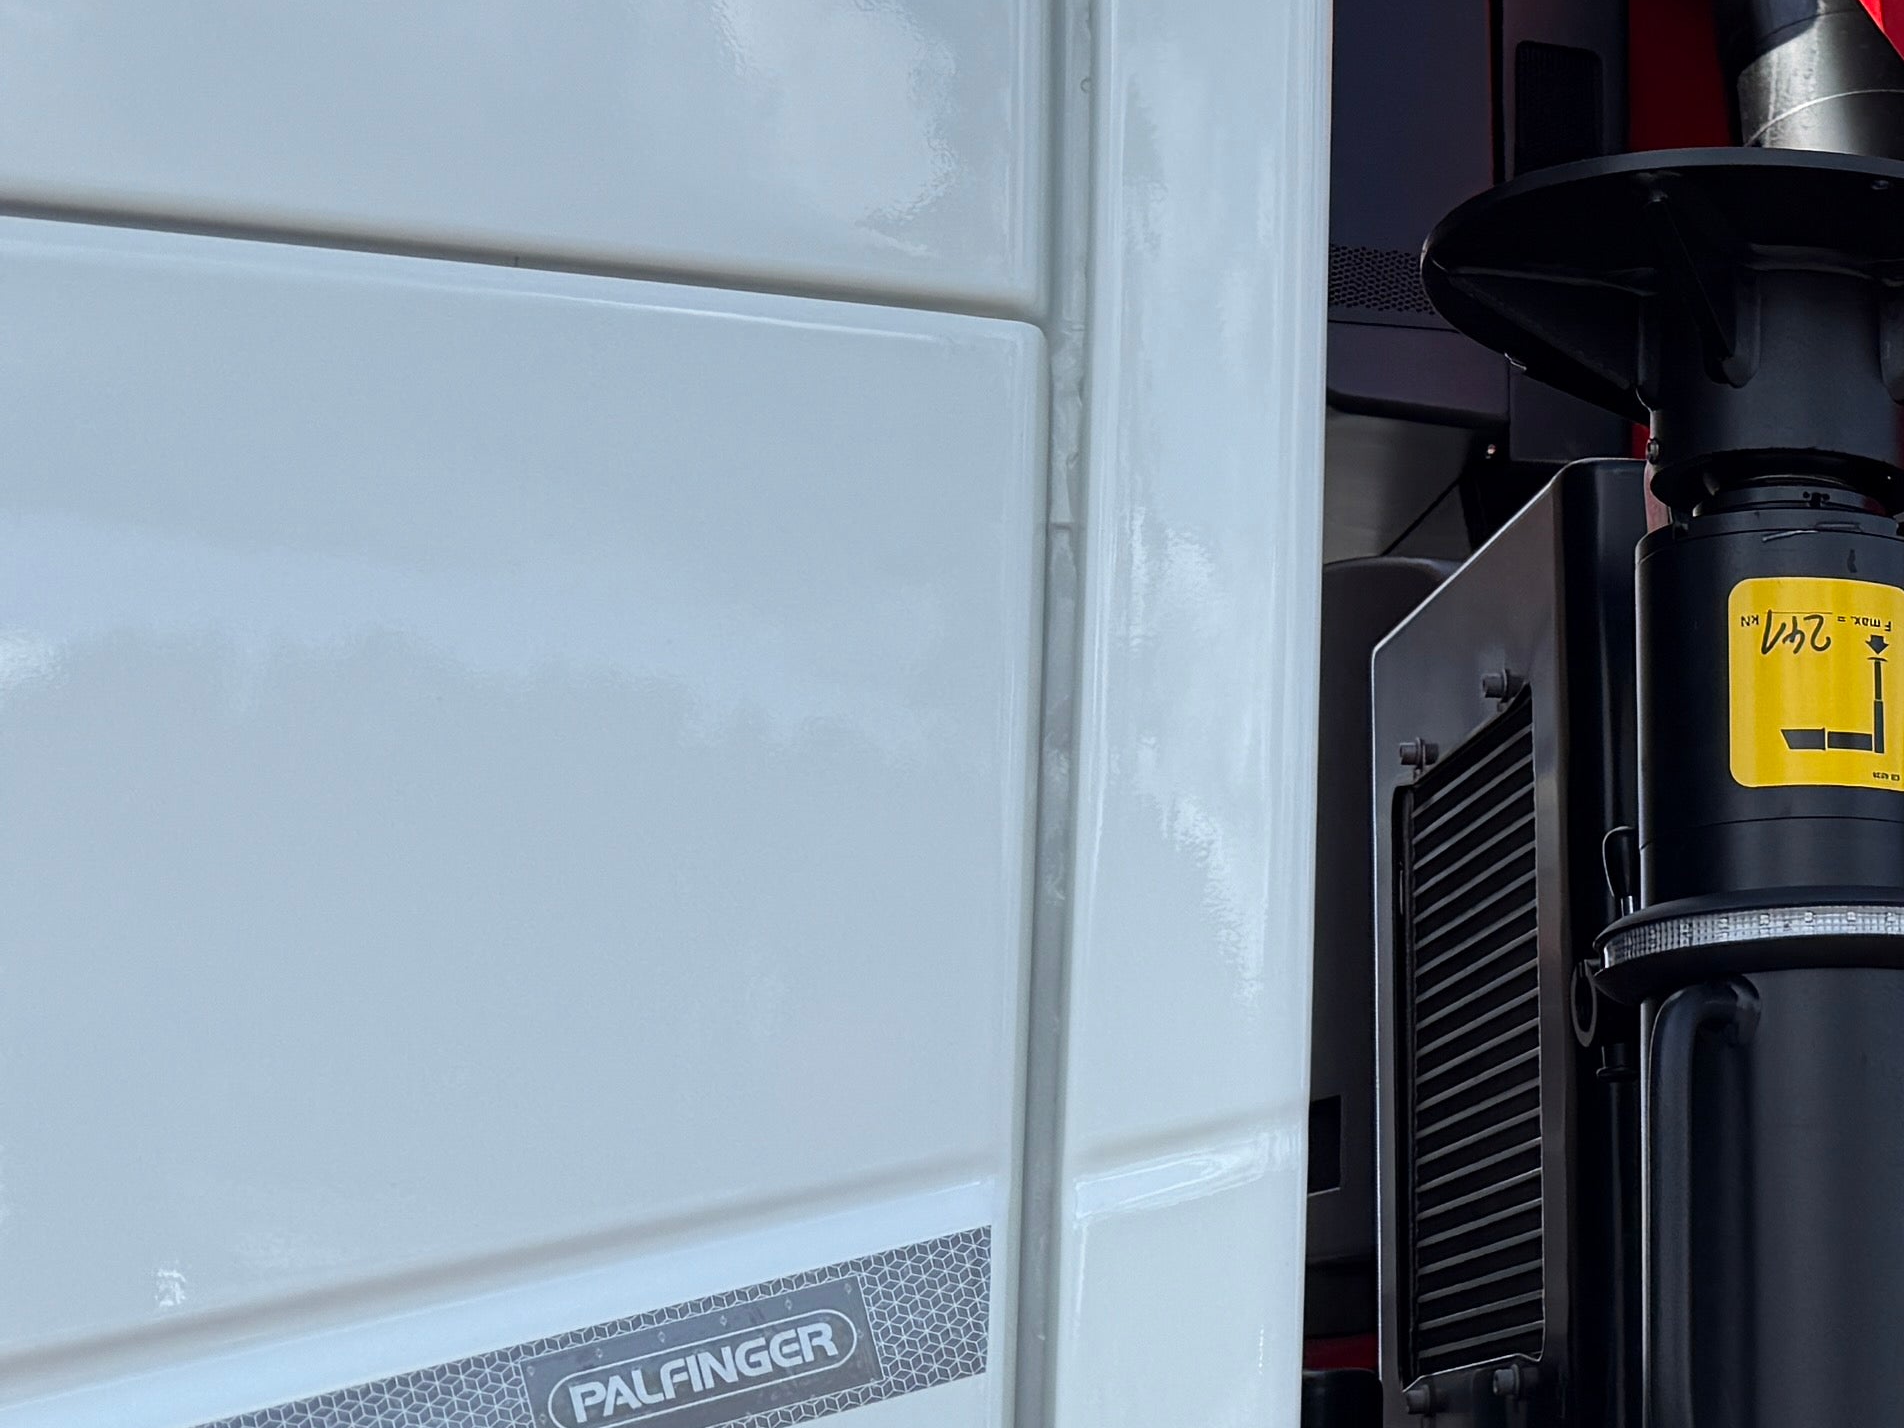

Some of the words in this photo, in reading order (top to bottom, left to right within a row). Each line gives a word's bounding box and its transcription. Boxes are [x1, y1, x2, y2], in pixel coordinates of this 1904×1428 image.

[1740, 614, 1760, 628] kN
[1850, 615, 1884, 628] max.
[1884, 621, 1892, 632] F
[569, 1322, 839, 1423] PALFINGER
